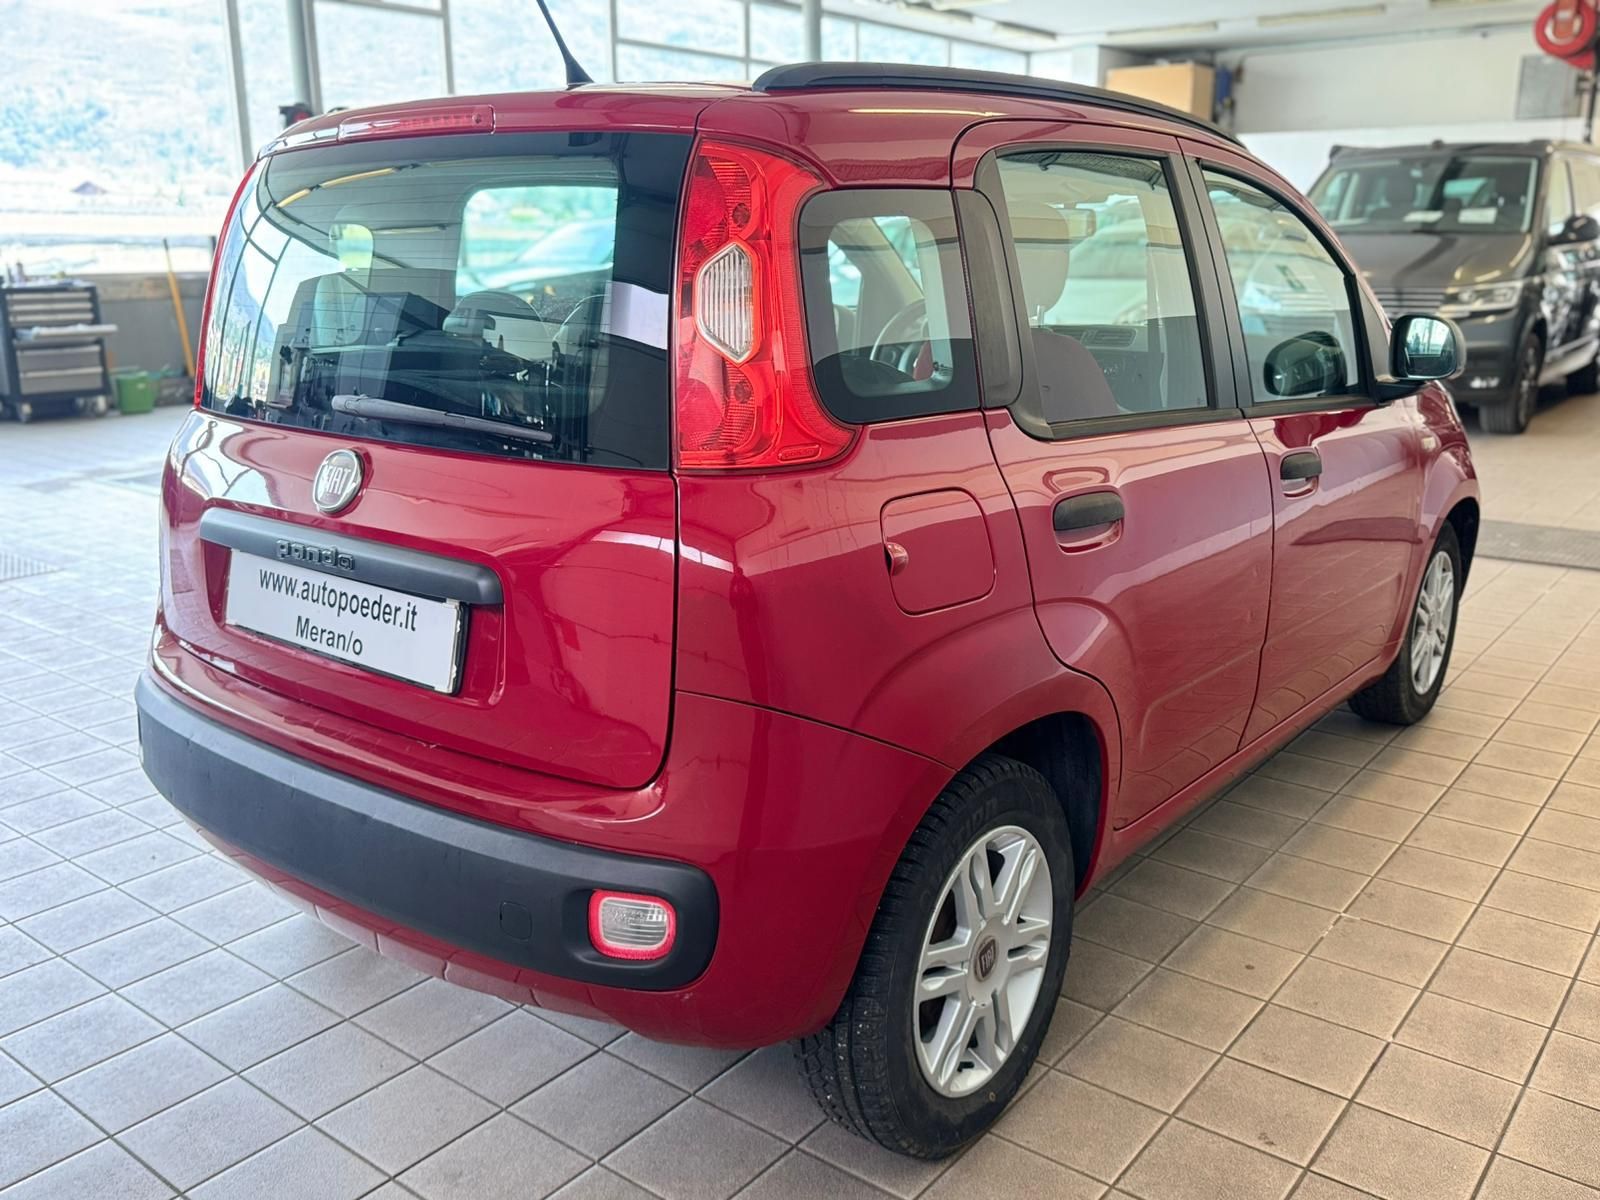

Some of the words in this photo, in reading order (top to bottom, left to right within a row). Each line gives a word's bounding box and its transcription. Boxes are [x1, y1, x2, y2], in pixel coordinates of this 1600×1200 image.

[320, 464, 352, 495] FIAT
[276, 539, 355, 571] panda
[259, 568, 418, 632] www.autopoeder.it
[295, 615, 363, 656] Meran/o
